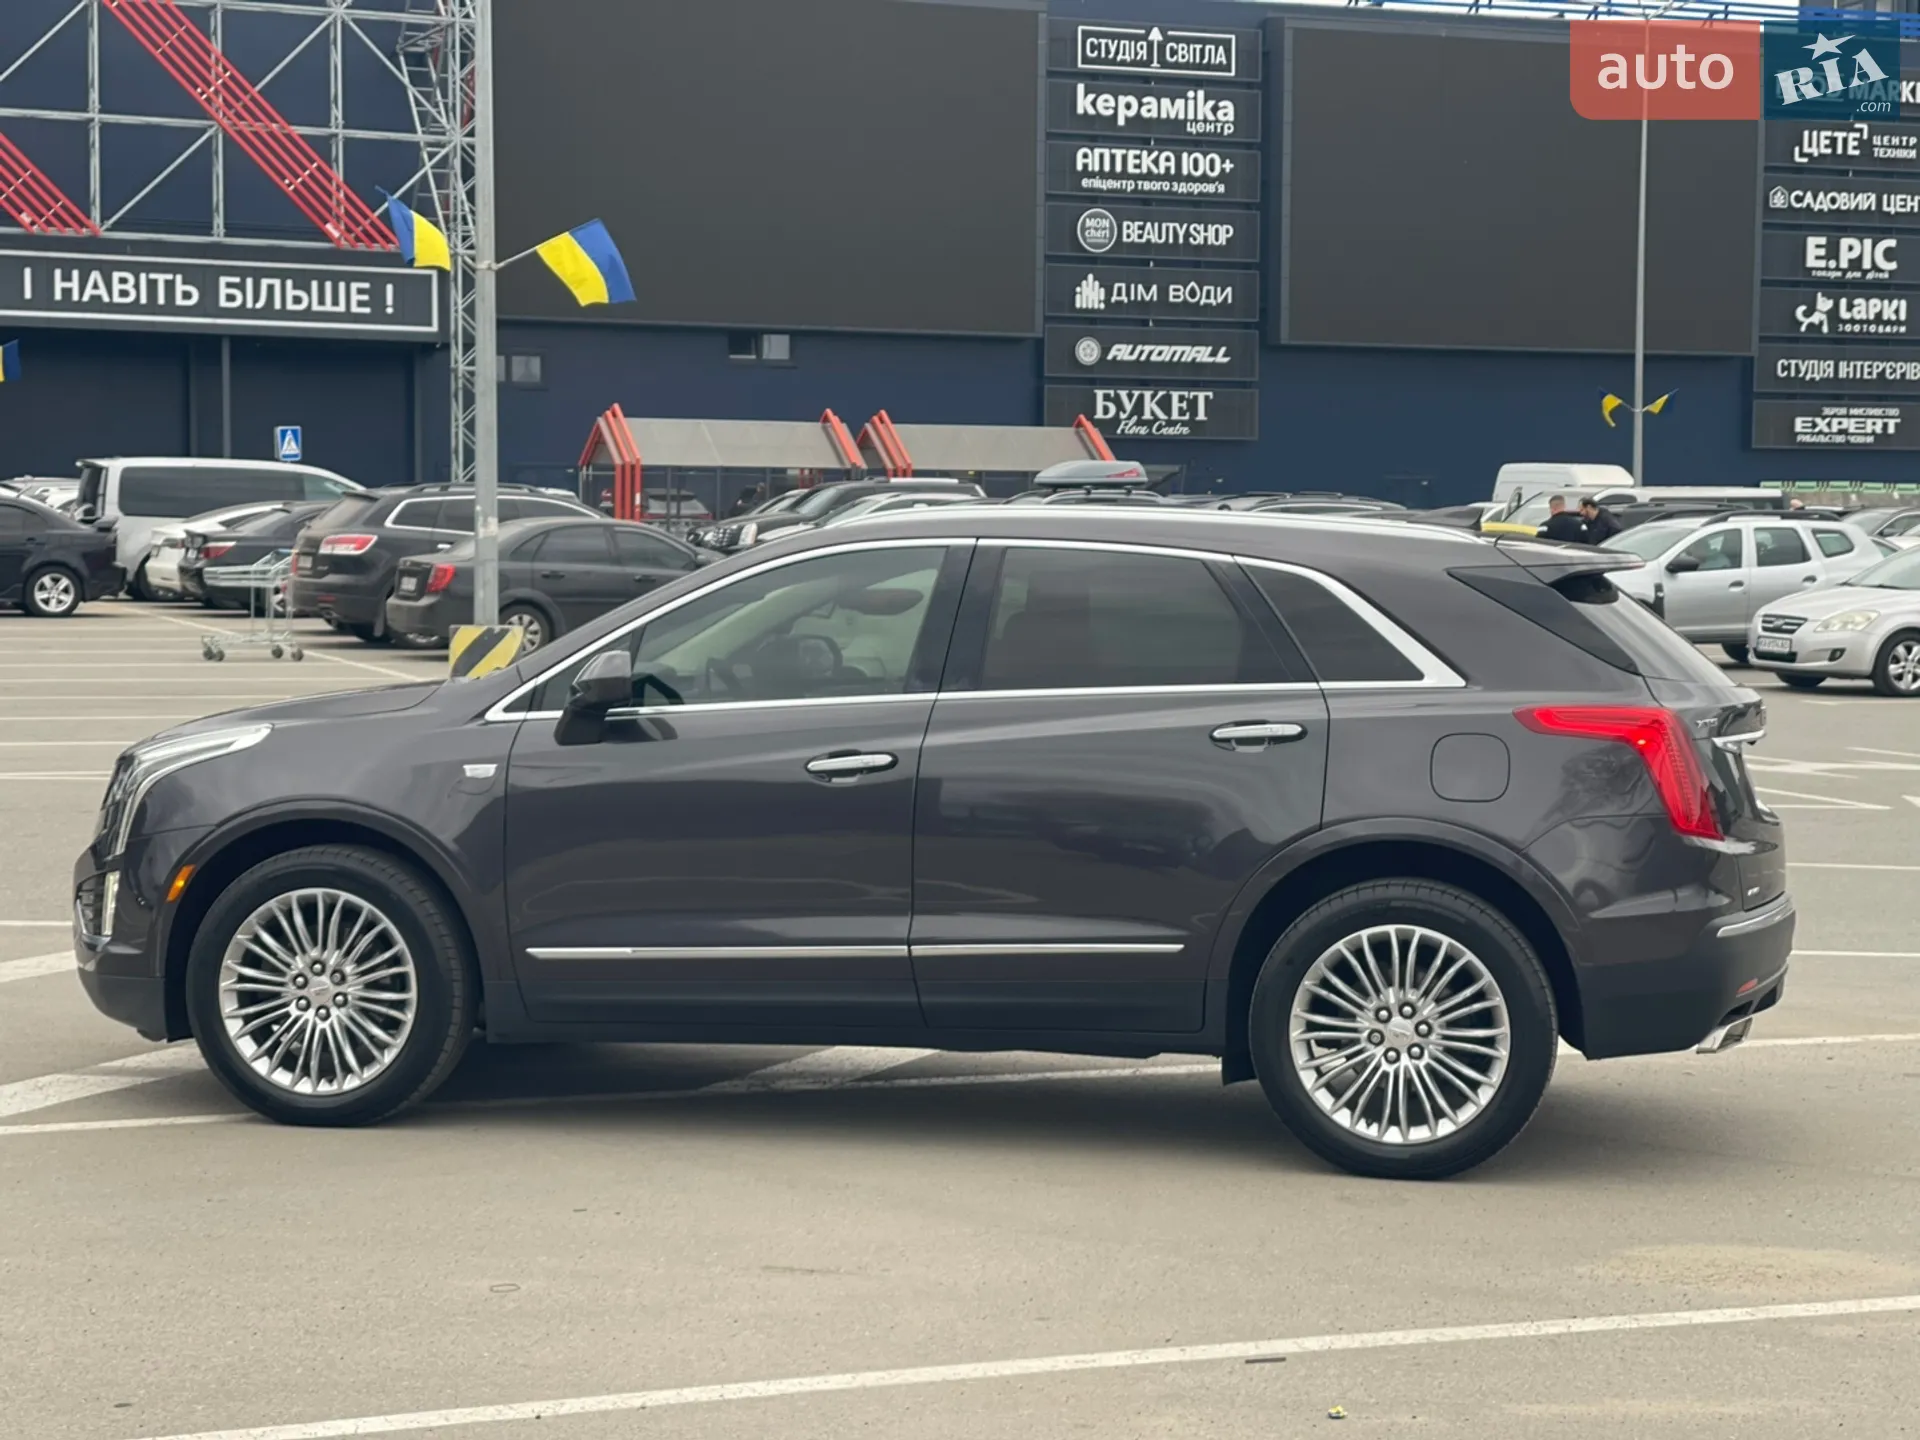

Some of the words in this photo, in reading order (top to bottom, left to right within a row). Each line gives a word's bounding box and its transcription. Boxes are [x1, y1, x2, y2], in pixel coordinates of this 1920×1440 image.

[1086, 37, 1148, 62] СТУДІЯ
[1165, 42, 1227, 65] СВІТЛА
[1186, 121, 1235, 136] центр
[1872, 134, 1918, 147] ЦЕНТР
[1802, 130, 1861, 157] ЦЕТЕ
[1076, 147, 1176, 175] АПТЕКА
[1182, 151, 1235, 178] 100+
[1081, 176, 1135, 192] епіцентр
[1136, 181, 1170, 191] твого
[1789, 189, 1877, 213] САДОВИЙ
[1882, 193, 1920, 215] ЦЕН
[1085, 217, 1110, 228] MON
[1122, 221, 1190, 245] BEAUTY
[1189, 224, 1235, 246] SHOP
[1805, 236, 1898, 271] E.PIC
[53, 268, 200, 307] НАВІТЬ
[218, 276, 372, 314] БІЛЬШЕ
[384, 283, 395, 314] !
[1111, 282, 1158, 304] ДІМ
[1169, 281, 1233, 306] ВОДИ
[1106, 343, 1232, 364] AUTOMALL
[1776, 359, 1835, 381] СТУДІЯ
[1093, 389, 1214, 421] БУКЕТ
[1794, 416, 1901, 434] EXPERT
